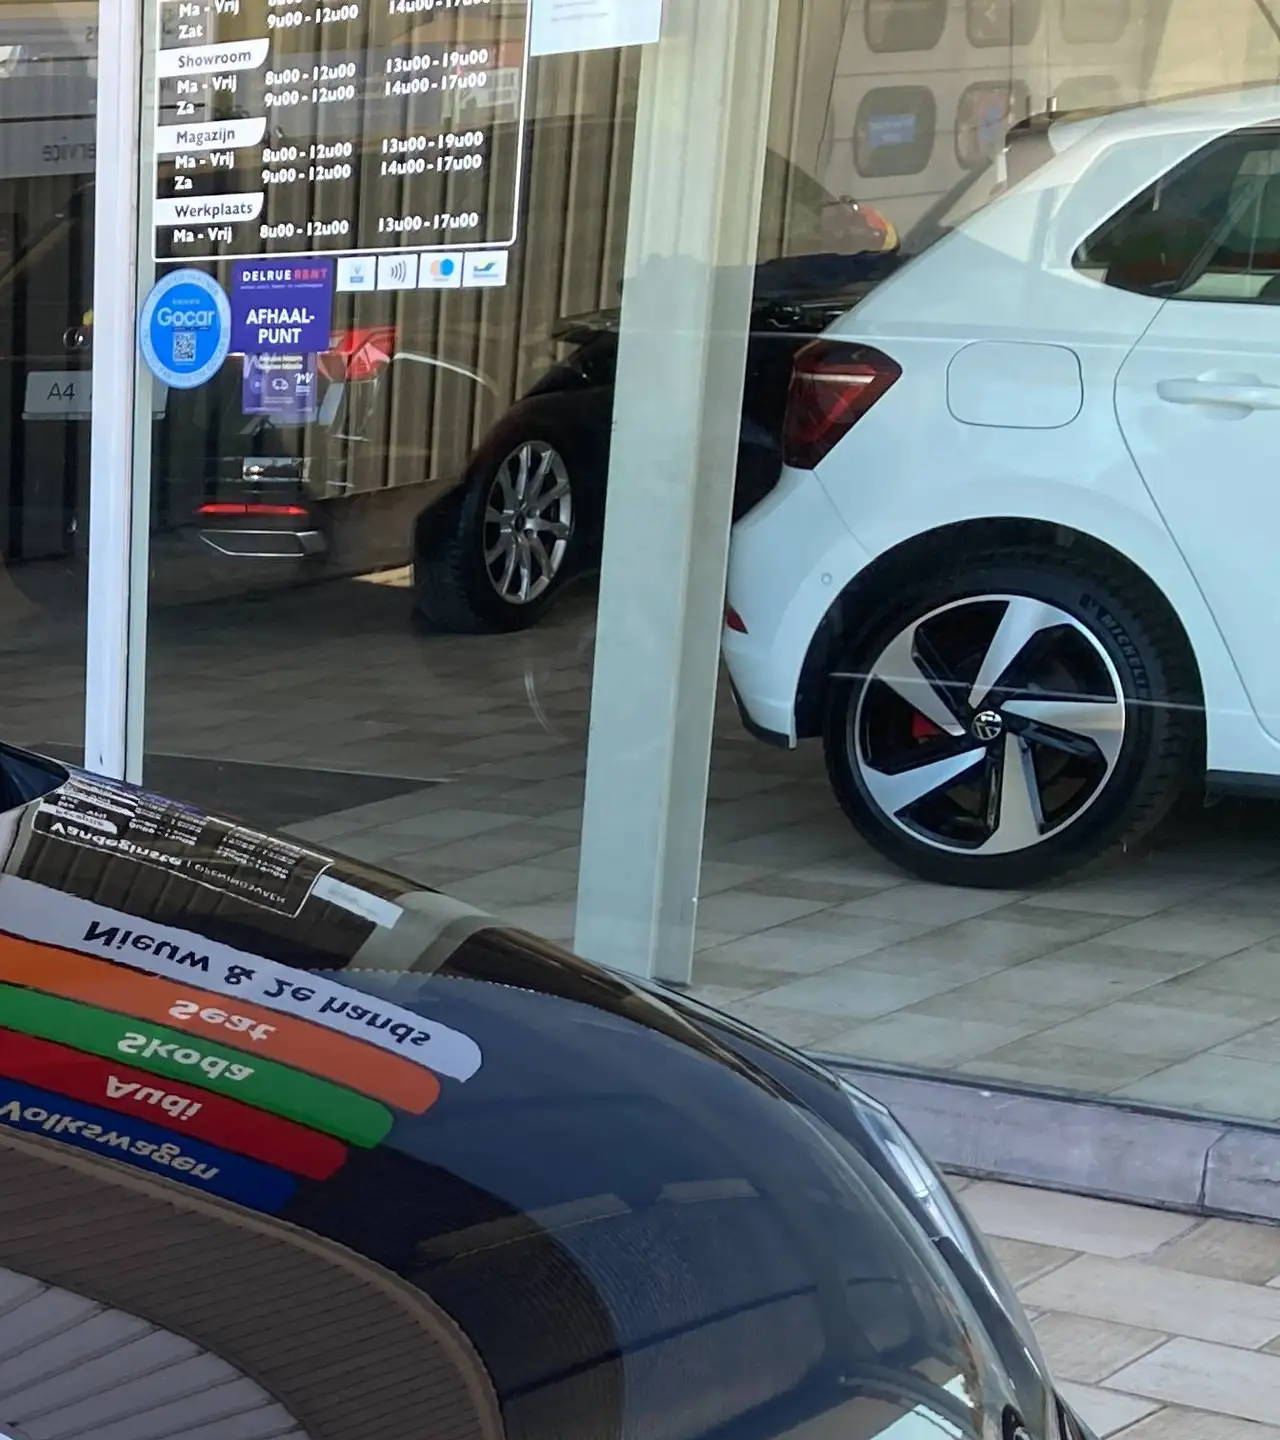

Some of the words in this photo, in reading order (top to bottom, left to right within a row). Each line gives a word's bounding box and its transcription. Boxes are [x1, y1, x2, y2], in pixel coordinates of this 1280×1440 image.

[179, 3, 200, 18] Ma
[215, 0, 240, 15] Vrij
[178, 24, 203, 39] Zat
[267, 11, 303, 29] 9u00
[315, 4, 359, 24] 12u00
[178, 51, 252, 68] Showroom
[177, 79, 198, 94] Ma
[212, 75, 237, 93] Vrij
[265, 69, 300, 85] 8u00
[312, 62, 356, 80] 12u00
[176, 100, 195, 115] Za
[264, 90, 299, 108] 9u00
[312, 85, 355, 104] 12u00
[176, 128, 235, 146] Magazijn
[175, 155, 196, 169] Ma
[210, 151, 235, 170] Vrij
[262, 146, 297, 163] 8u00
[310, 142, 352, 159] 12u00
[174, 175, 193, 190] Za
[262, 168, 296, 184] 9u00
[309, 164, 351, 181] 12u00
[174, 203, 253, 219] Werkplaats
[173, 229, 194, 243] Ma
[207, 226, 232, 245] Vrij
[260, 224, 294, 238] 8u00
[307, 220, 349, 236] 12u00
[242, 269, 291, 282] DELRUE
[157, 307, 215, 326] Gocar
[246, 308, 315, 325] AFHAAL-
[258, 328, 302, 344] PUNT
[46, 382, 77, 401] A4
